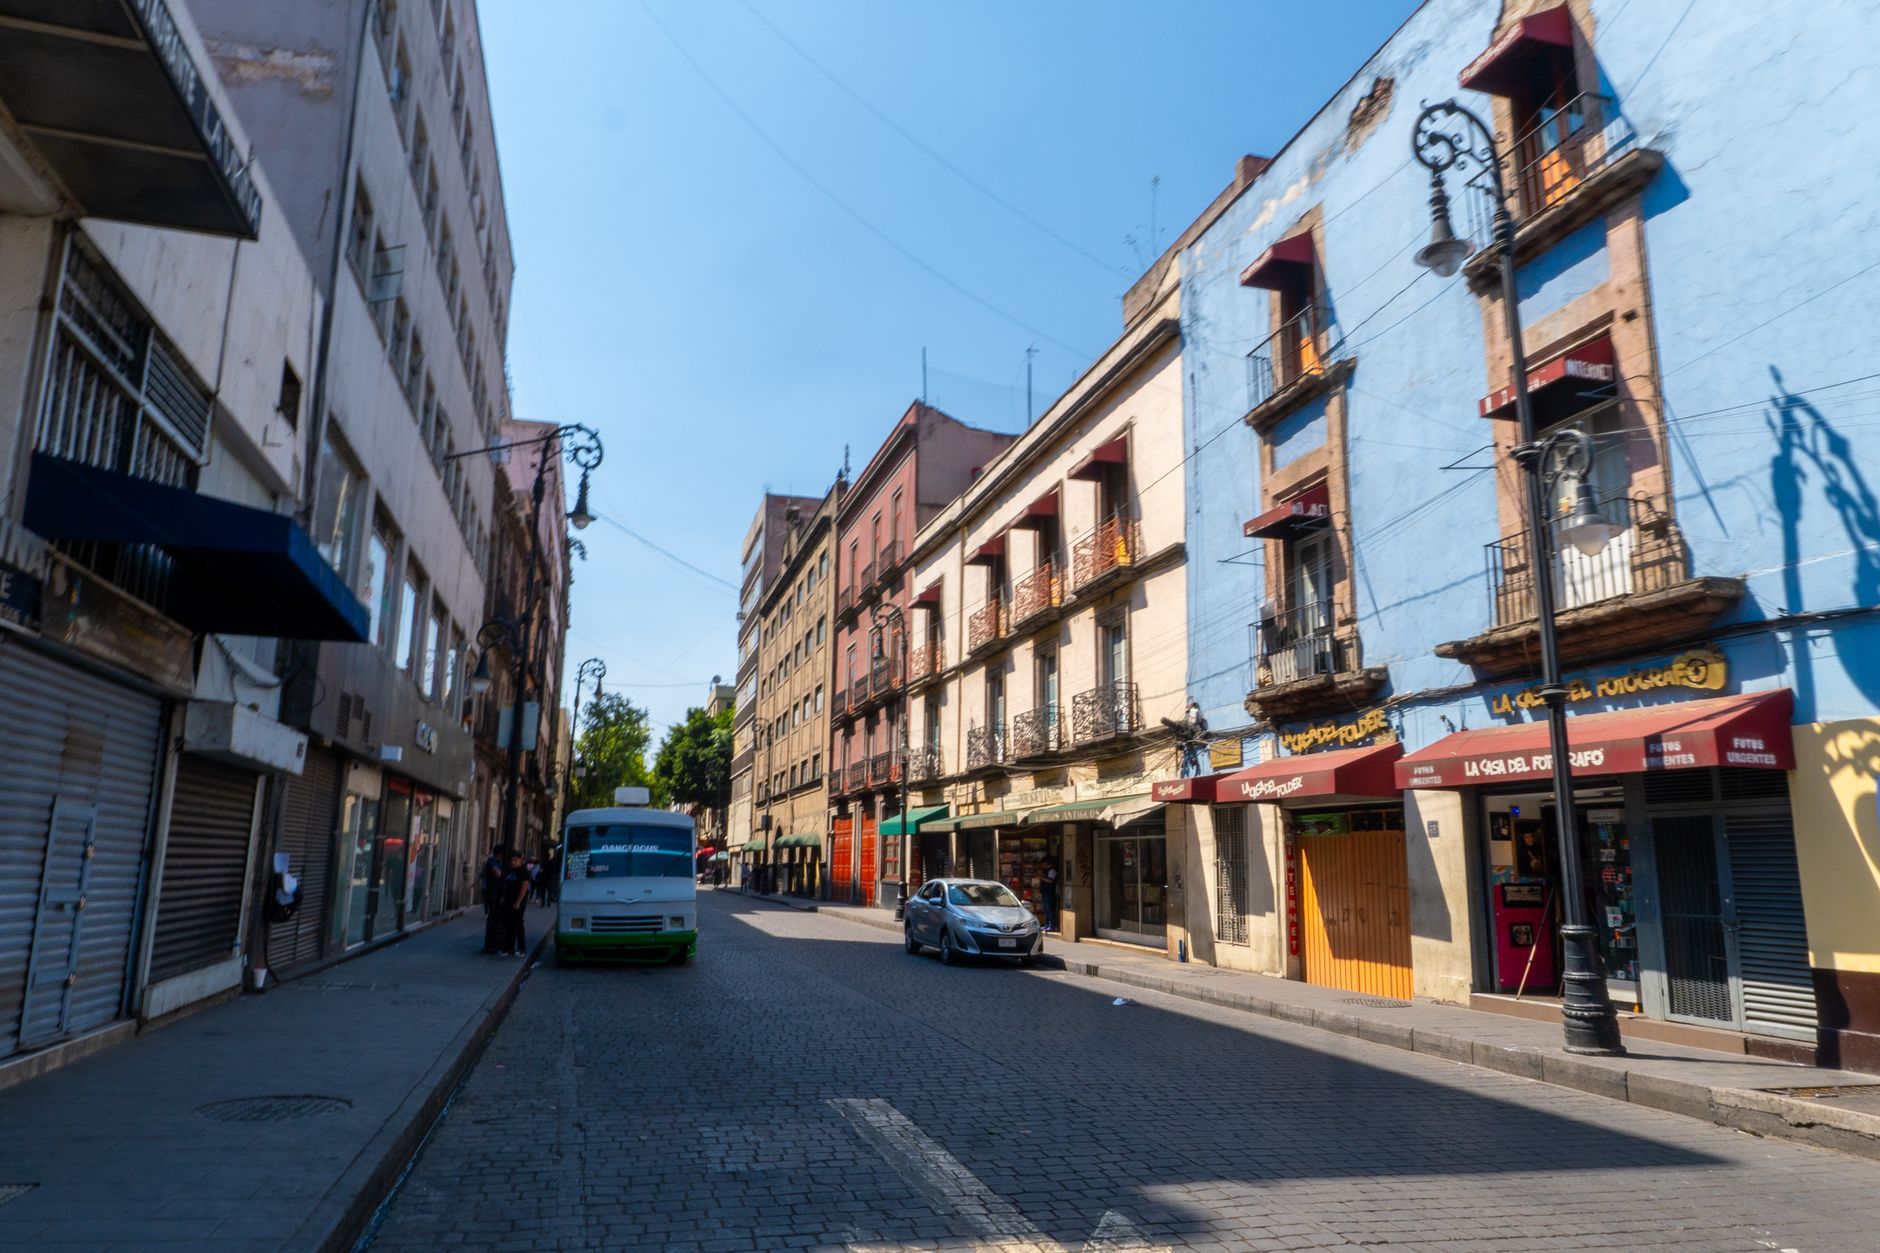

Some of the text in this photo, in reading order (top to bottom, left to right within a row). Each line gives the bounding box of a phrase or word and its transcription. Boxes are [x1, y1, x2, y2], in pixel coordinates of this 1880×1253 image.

[1492, 692, 1513, 714] LA
[1566, 681, 1593, 701] EL
[1597, 658, 1710, 698] FOTOGRAFO
[1279, 730, 1294, 749] LA
[1291, 725, 1317, 752] CASA
[1315, 722, 1340, 744] DEL
[1336, 709, 1388, 746] FOLDER
[1649, 741, 1682, 753] FOTOS
[1733, 737, 1764, 750] FOTOS
[1464, 749, 1605, 777] LA CASA DEL FOTRAFO
[1642, 753, 1695, 768] URGENTES
[1727, 751, 1777, 765] URGENTES
[1241, 776, 1303, 799] LA CASA DEL FOLDER
[1285, 845, 1298, 952] INTERNET
